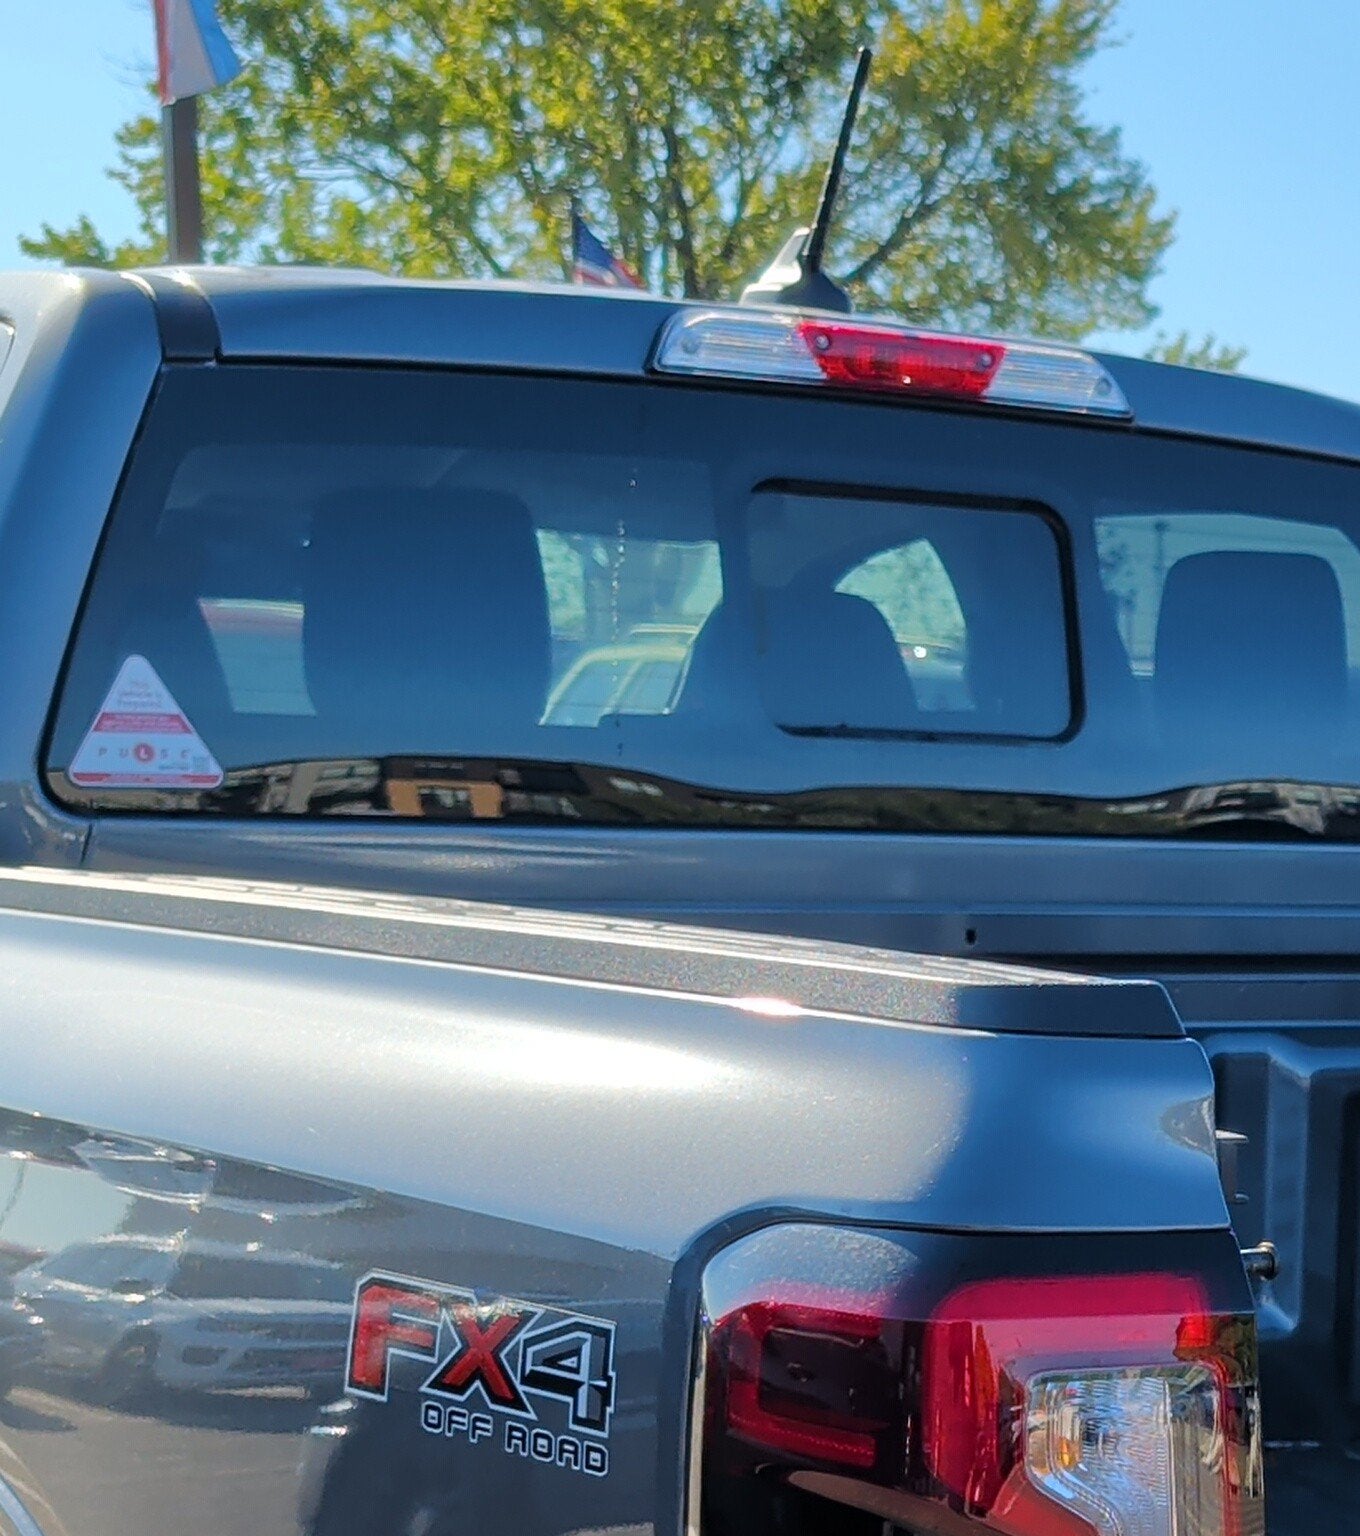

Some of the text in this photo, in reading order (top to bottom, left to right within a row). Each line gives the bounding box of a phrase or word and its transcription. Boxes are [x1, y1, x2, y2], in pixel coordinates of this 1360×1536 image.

[344, 1268, 618, 1438] FX4
[420, 1400, 608, 1477] OFF ROAD
